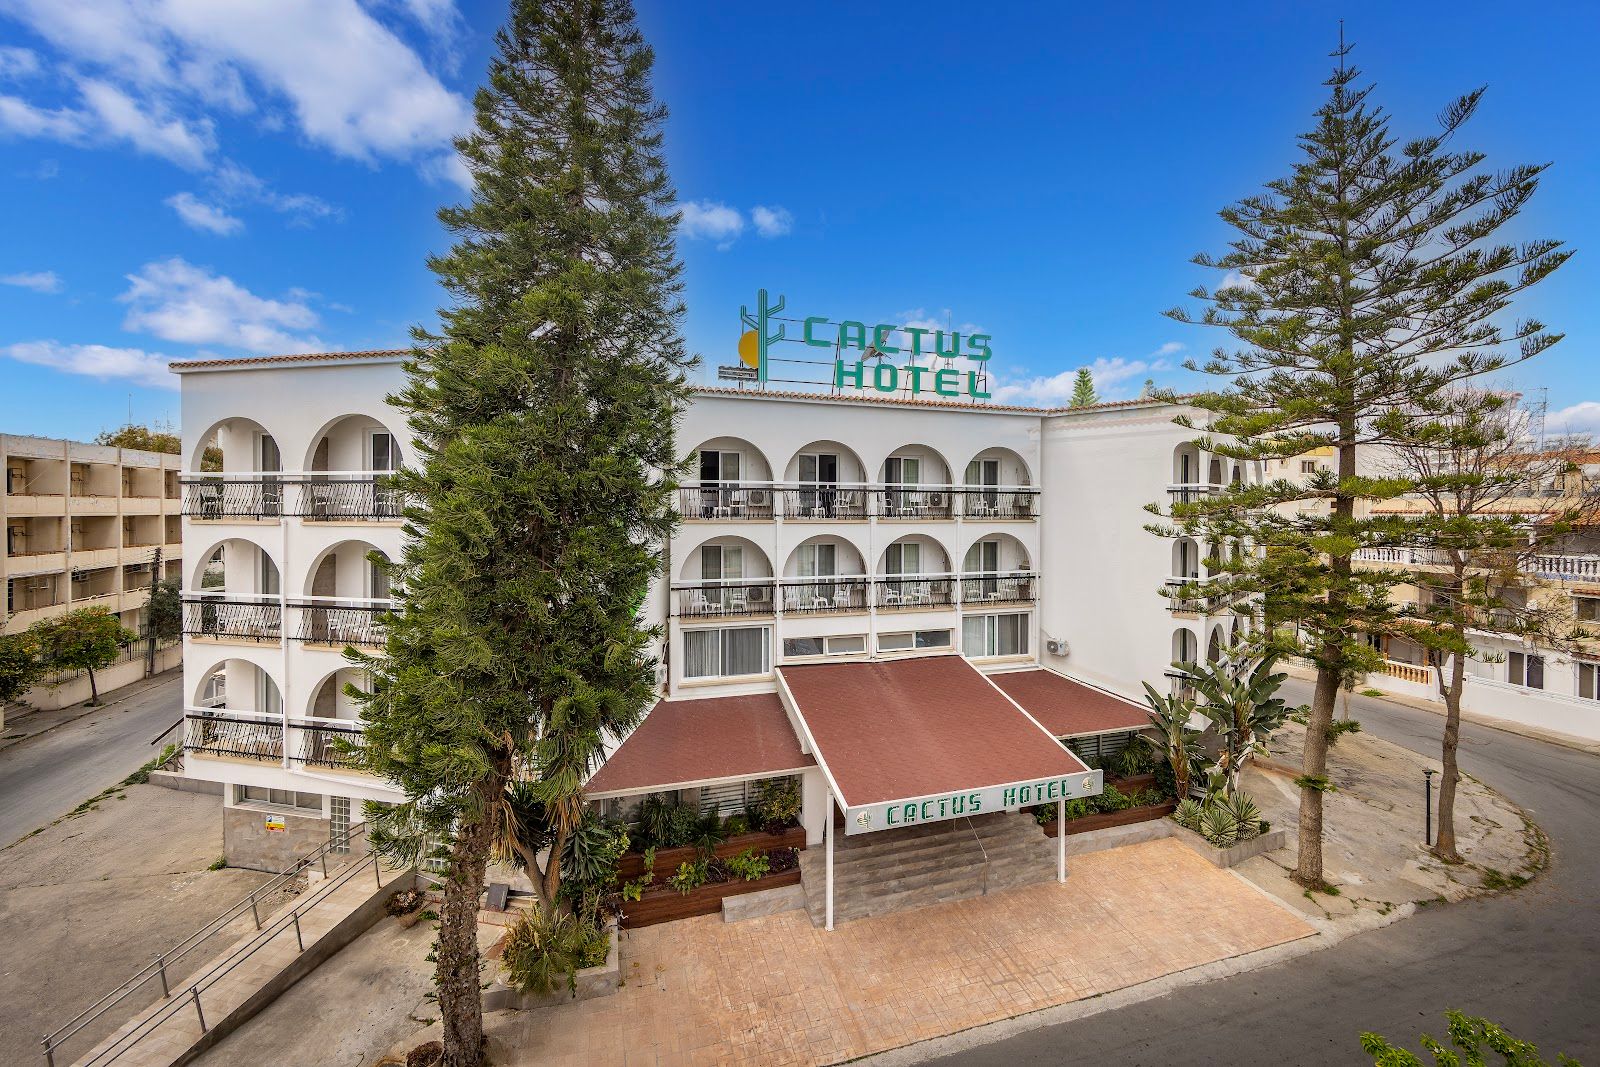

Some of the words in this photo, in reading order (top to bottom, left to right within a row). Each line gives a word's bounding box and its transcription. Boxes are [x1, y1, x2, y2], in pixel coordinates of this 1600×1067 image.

[804, 316, 992, 361] CACTUS
[835, 359, 992, 399] HOTEL
[887, 793, 982, 826] CACTUS
[1003, 779, 1072, 807] HOTEL
